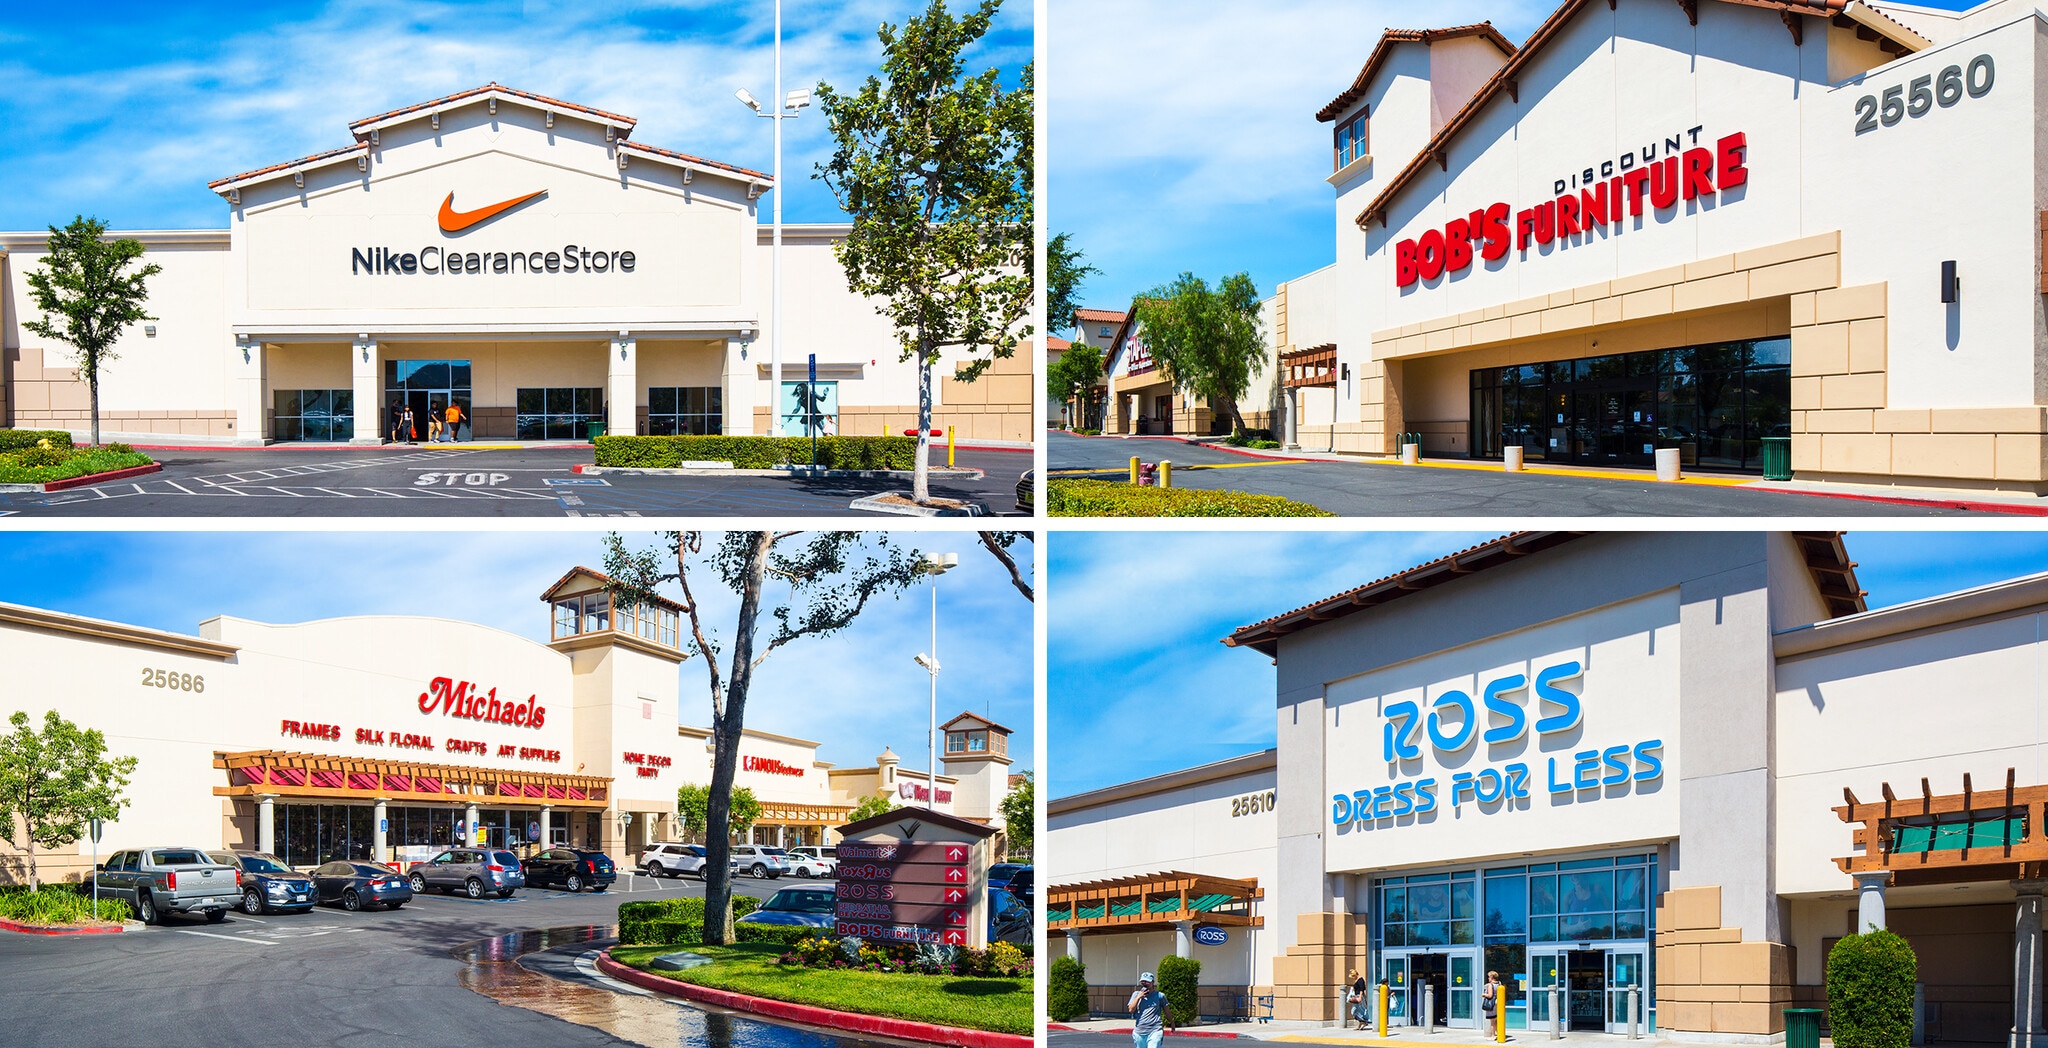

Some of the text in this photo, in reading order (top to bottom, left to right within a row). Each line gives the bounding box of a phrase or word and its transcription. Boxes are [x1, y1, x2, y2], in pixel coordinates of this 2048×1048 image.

[1854, 53, 1996, 137] 25560
[1554, 125, 1703, 194] DISCOUNT
[1395, 131, 1749, 287] BOB'S FURNITURE
[413, 472, 511, 486] STOP
[141, 667, 205, 694] 25686
[418, 676, 546, 728] Michaels
[1383, 660, 1586, 764] ROSS
[281, 719, 561, 761] FRAMES SILK FLORAL CRAFTS ART SUPPLIES
[623, 751, 672, 768] HOME DECOR
[751, 756, 781, 774] FAMOUS
[637, 766, 660, 778] PARTY
[1332, 738, 1664, 826] DRESS FOR LESS
[1232, 791, 1275, 818] 25610
[838, 846, 883, 859] Walmart
[837, 884, 894, 899] ROSS
[838, 911, 891, 920] BEYOND
[838, 922, 882, 937] BOB'S
[1200, 930, 1225, 941] ROSS
